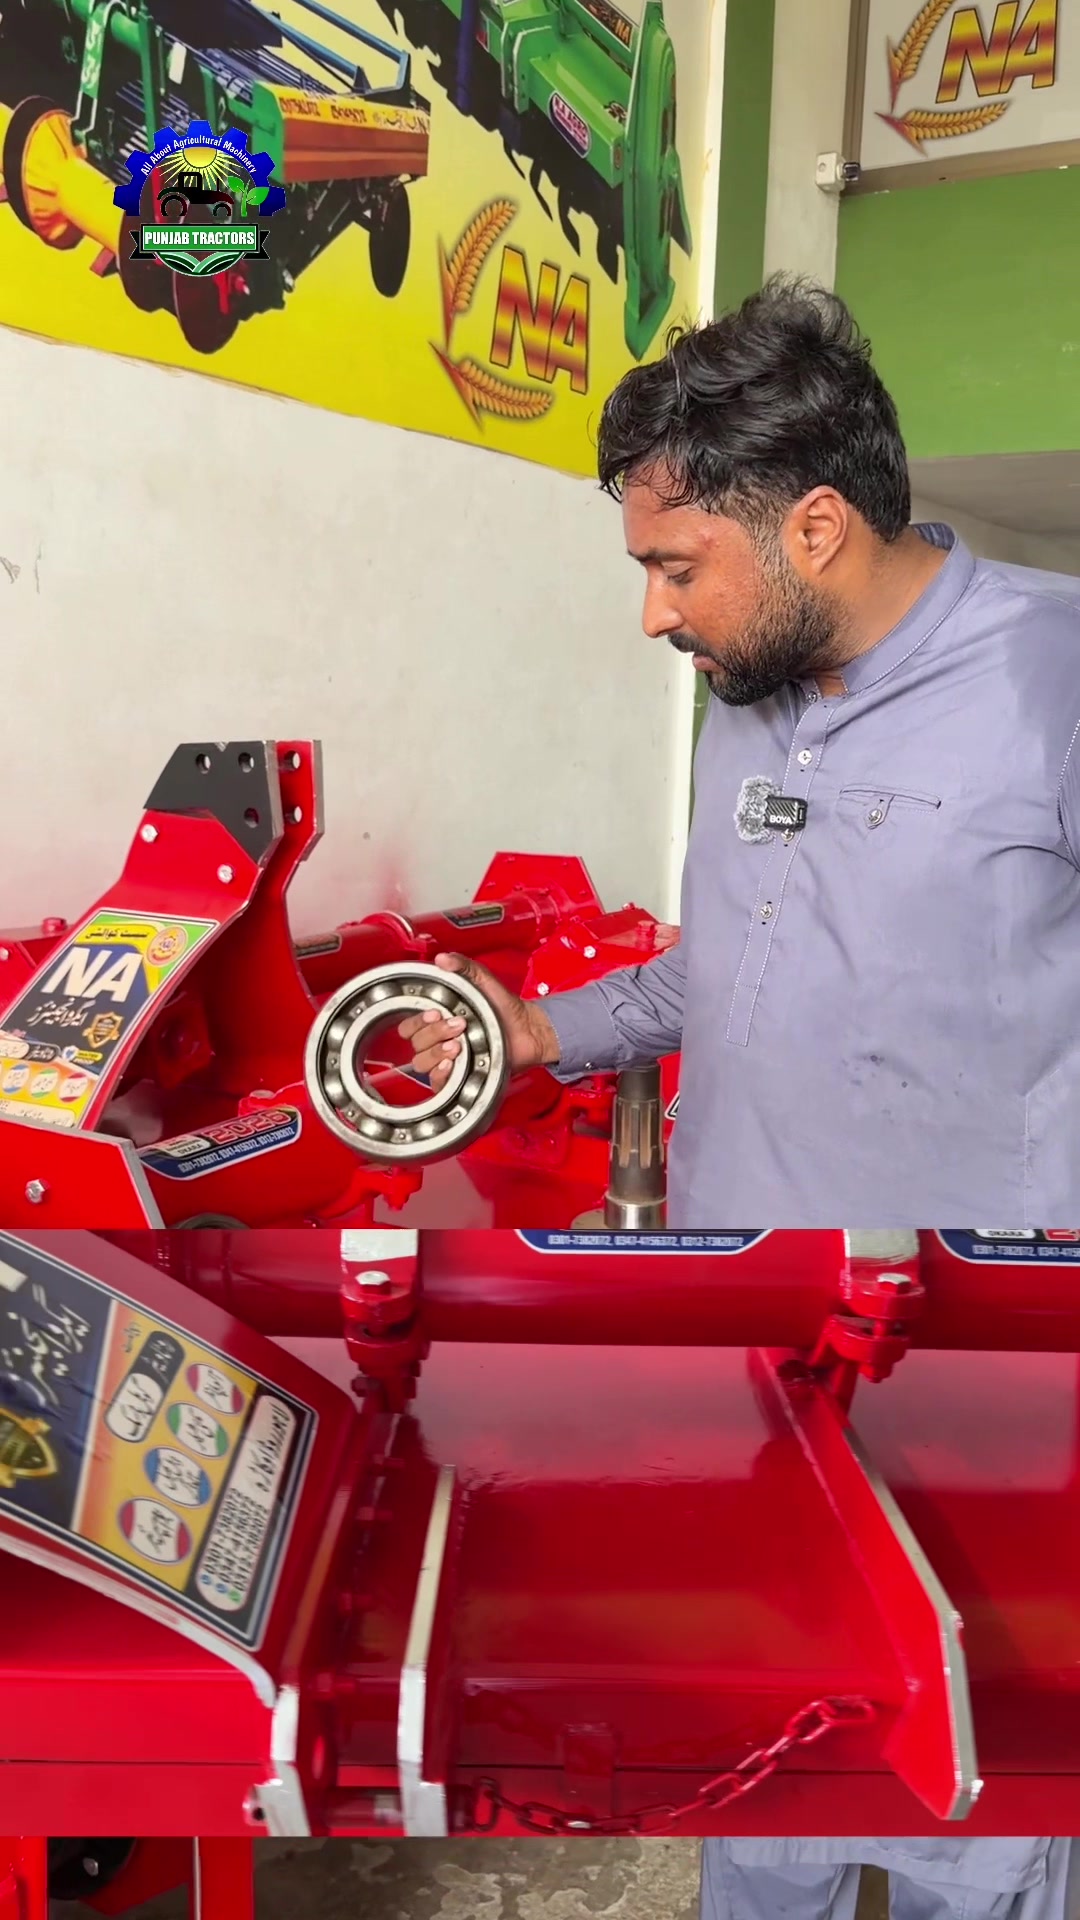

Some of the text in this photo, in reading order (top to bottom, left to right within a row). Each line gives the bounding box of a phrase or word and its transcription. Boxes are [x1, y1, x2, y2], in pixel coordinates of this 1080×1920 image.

[935, 0, 1058, 104] NA
[490, 245, 590, 396] NA
[769, 814, 793, 825] BOYA
[41, 946, 143, 1003] NA
